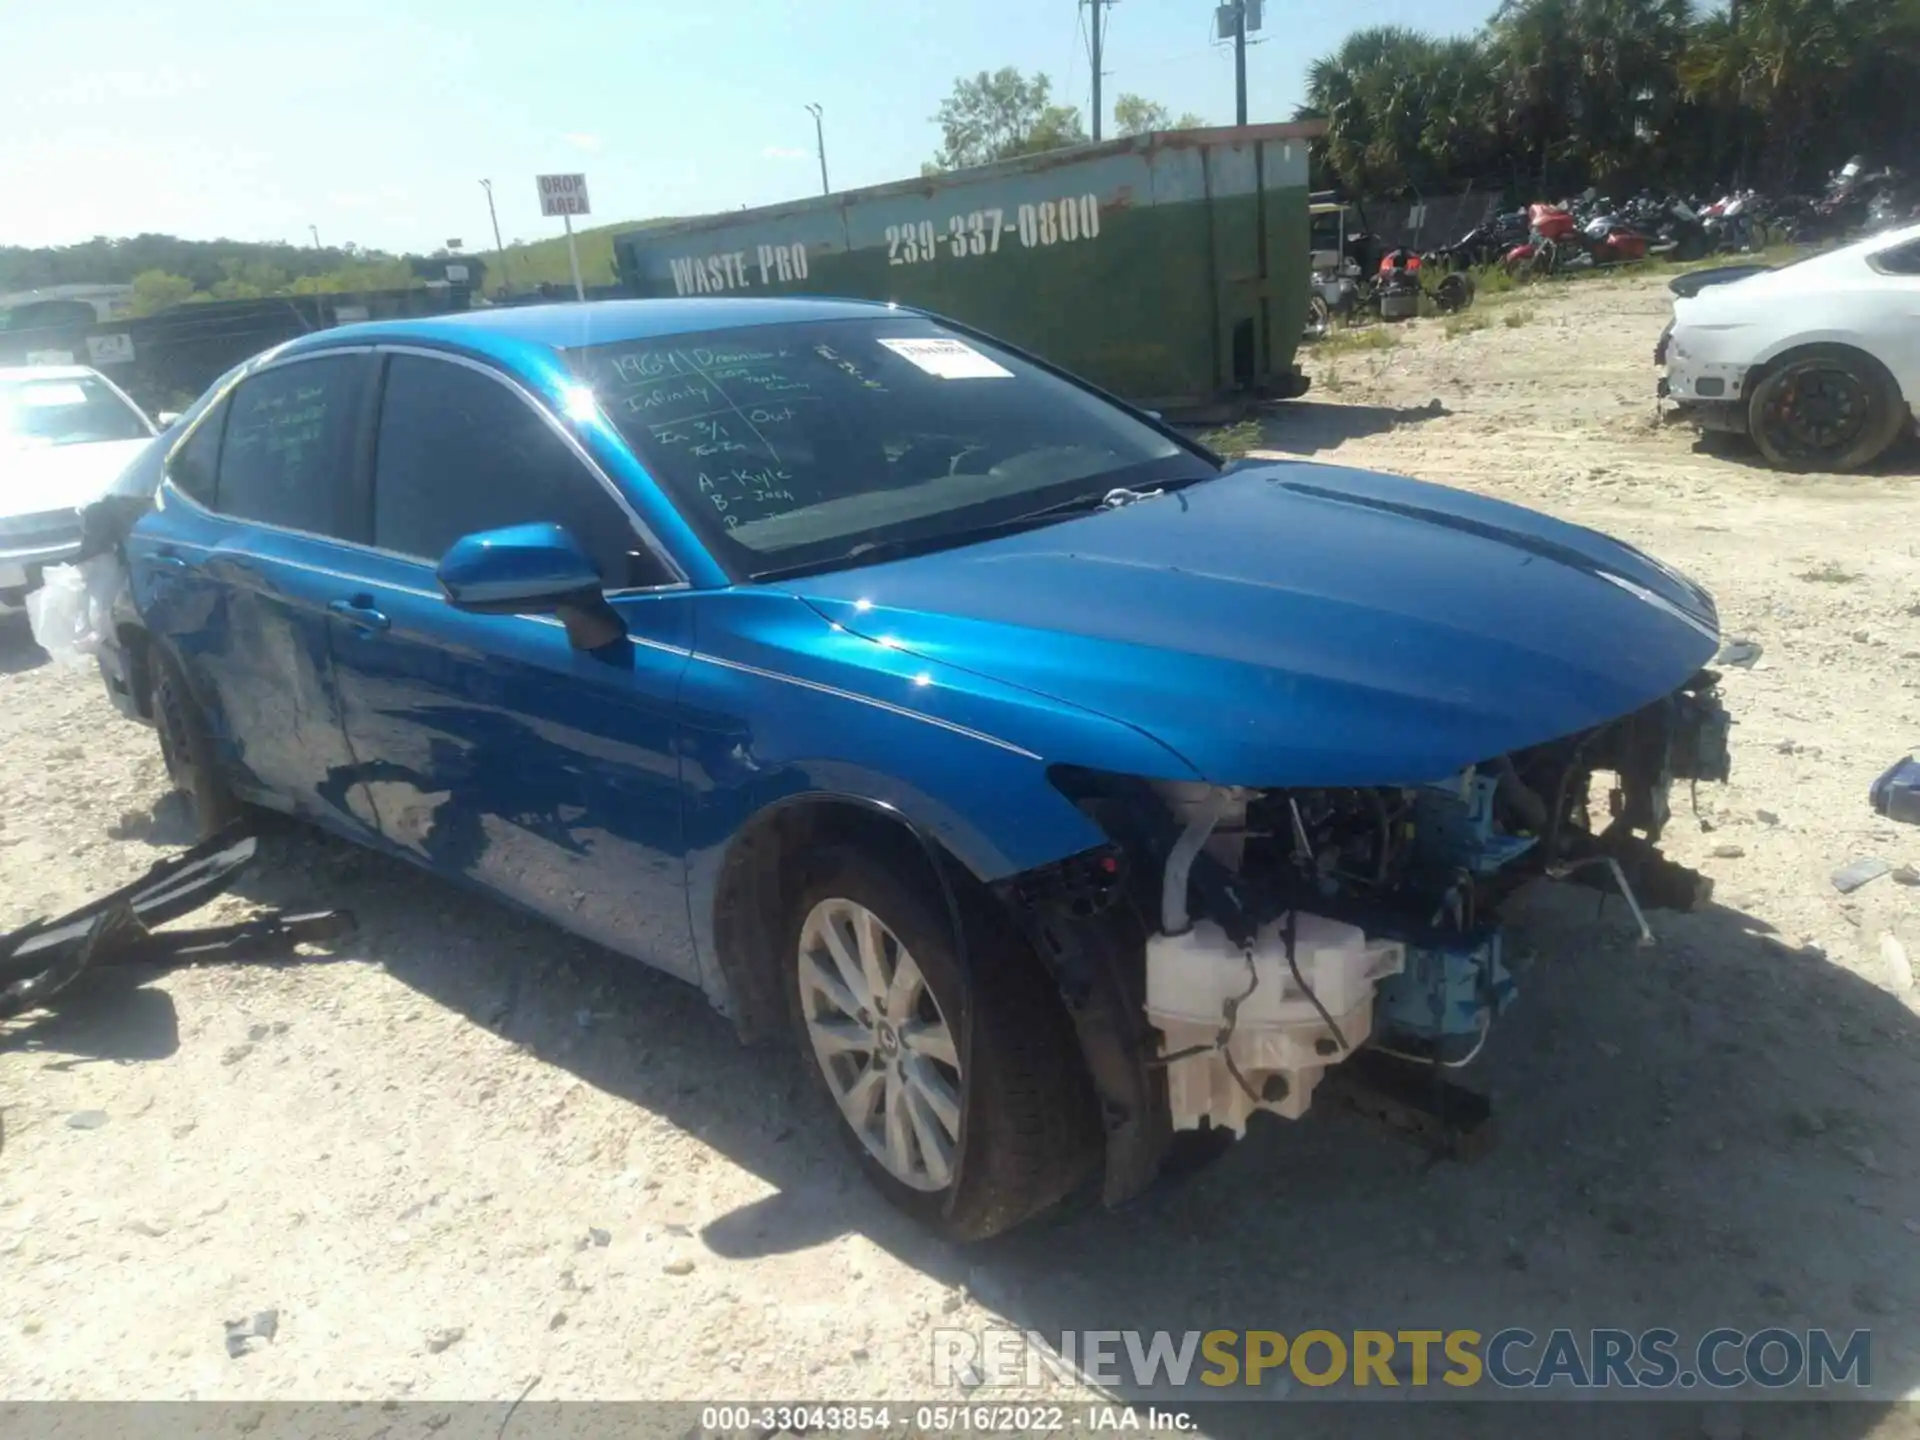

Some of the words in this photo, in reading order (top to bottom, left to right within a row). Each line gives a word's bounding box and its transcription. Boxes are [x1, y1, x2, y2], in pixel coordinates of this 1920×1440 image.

[541, 175, 582, 194] DROP
[547, 197, 588, 214] AREA
[885, 194, 1099, 266] 239-337-0800
[670, 252, 749, 296] WASTE
[758, 243, 808, 283] PRO
